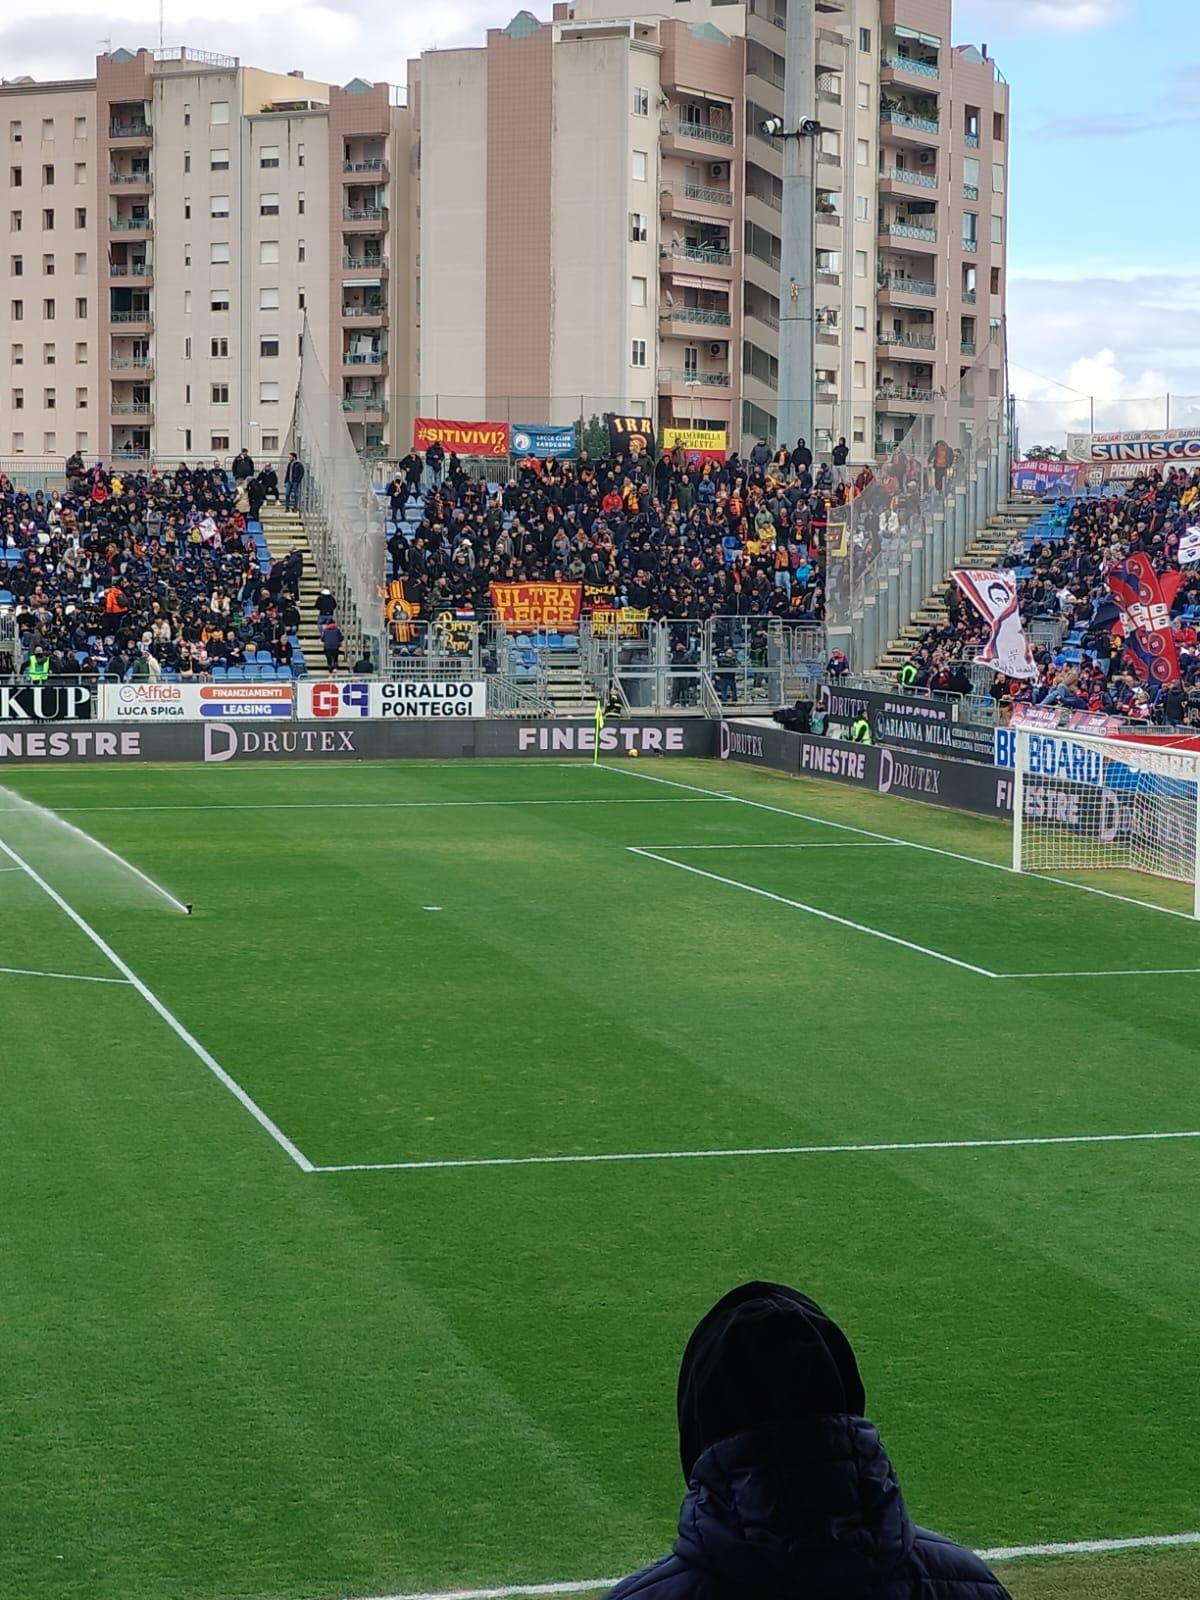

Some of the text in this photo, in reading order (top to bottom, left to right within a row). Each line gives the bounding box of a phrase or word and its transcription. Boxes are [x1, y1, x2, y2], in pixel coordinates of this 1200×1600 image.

[584, 585, 616, 596] SENZA
[496, 607, 574, 625] LECCE
[137, 685, 181, 699] Affida
[212, 689, 283, 698] FINANZIAMENTI
[381, 684, 474, 698] GIRALDO
[117, 706, 184, 716] LUCA SPIGA
[222, 705, 272, 715] LEASING
[381, 702, 473, 716] PONTEGGI
[0, 732, 141, 757] NESTRE
[242, 731, 356, 753] DRUTEX
[519, 728, 684, 750] FINESTRE
[925, 724, 952, 746] MILIA
[731, 734, 765, 758] DRUTEX
[801, 743, 866, 780] FINESTRE
[1029, 734, 1103, 785] BOARD
[894, 764, 941, 795] DRUTEX
